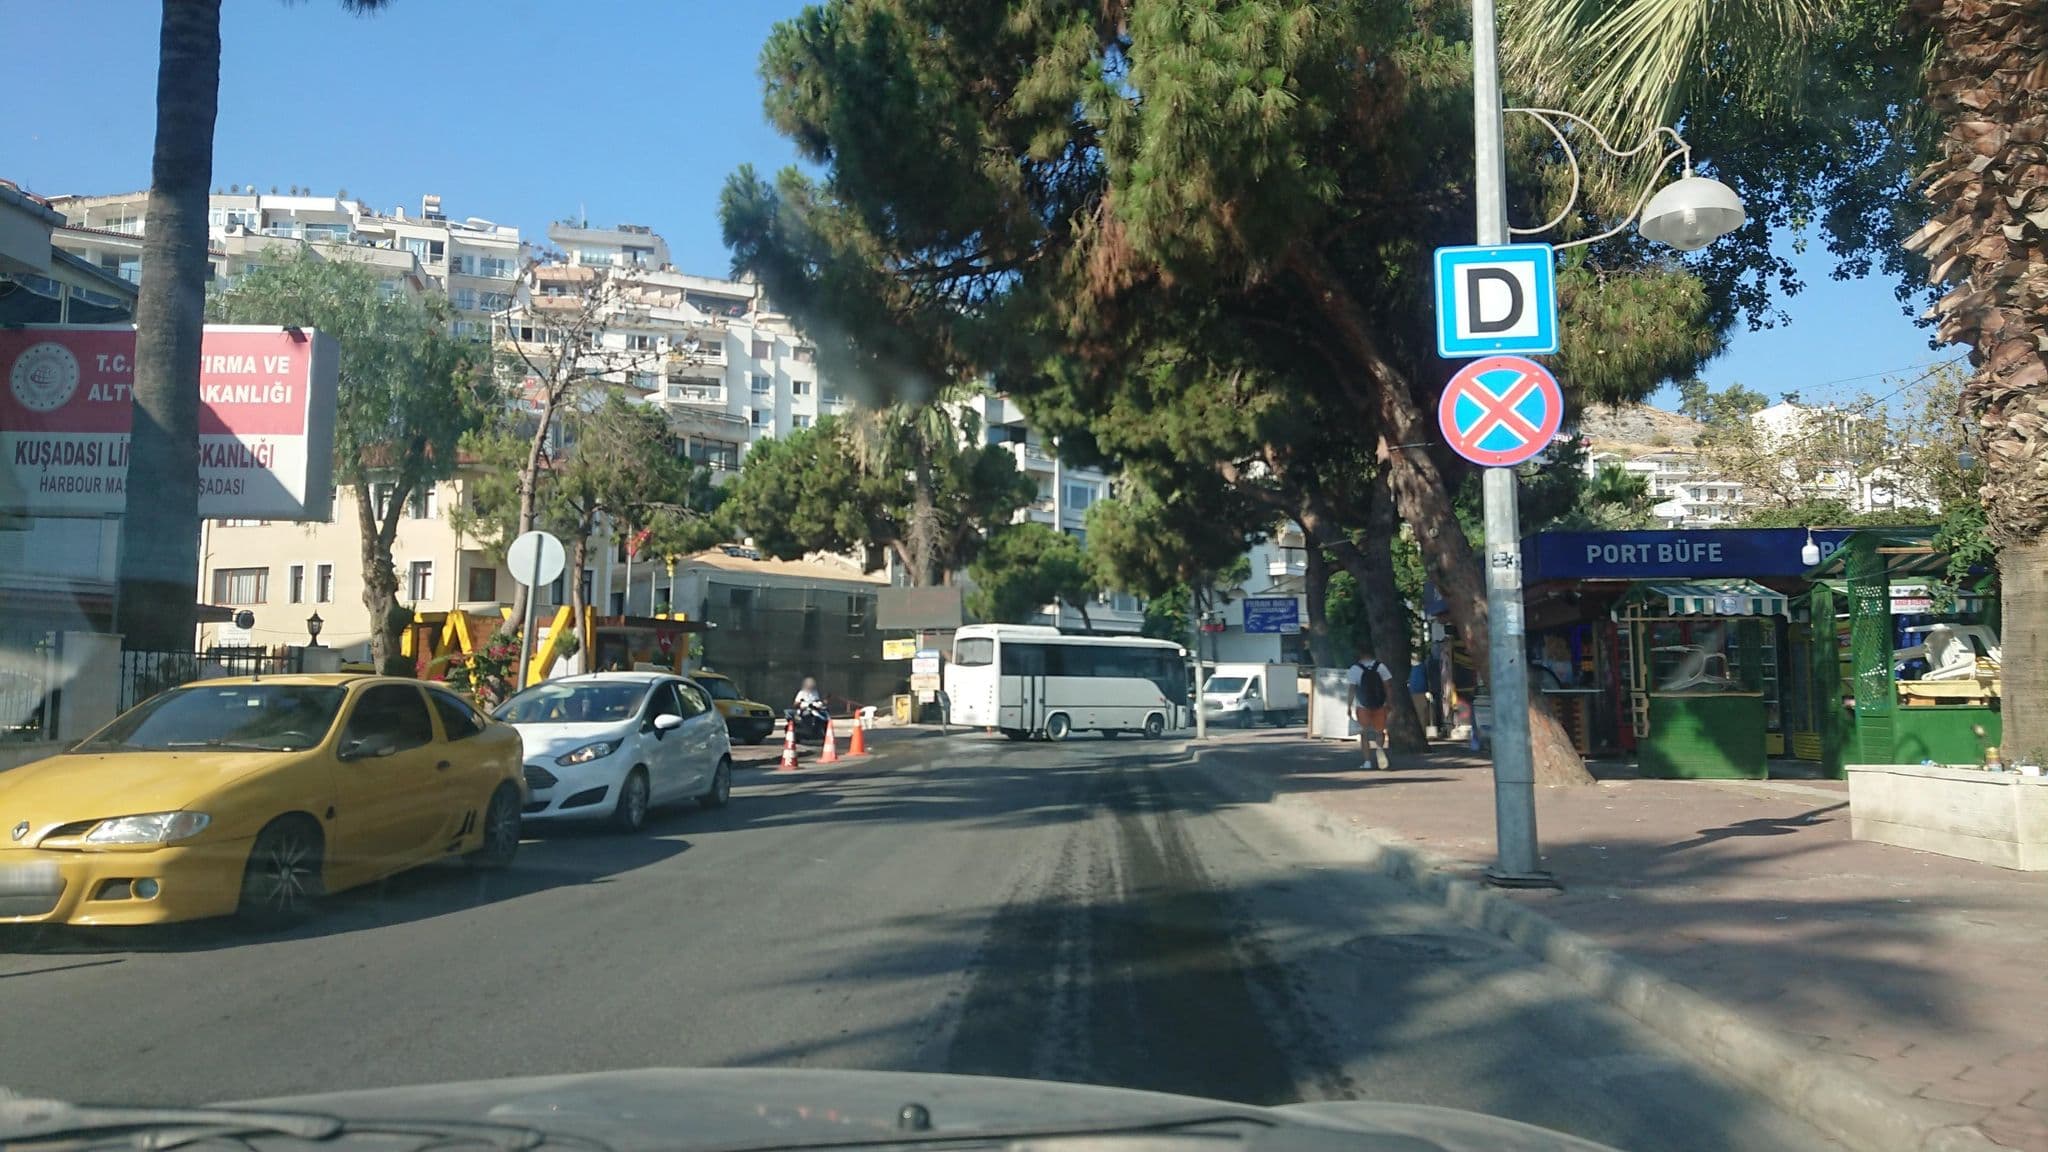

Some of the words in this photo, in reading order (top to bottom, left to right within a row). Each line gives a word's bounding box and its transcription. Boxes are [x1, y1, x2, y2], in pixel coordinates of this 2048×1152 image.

[1466, 268, 1524, 333] D
[96, 355, 131, 372] T.C.
[201, 355, 257, 374] IRMA
[263, 355, 291, 374] VE
[15, 440, 102, 472] KUŞADASI
[199, 438, 274, 469] KANLIĞI
[39, 476, 102, 493] HARBOUR
[105, 477, 126, 494] MA
[199, 478, 245, 496] ŞADASI
[1586, 543, 1652, 564] PORT
[1657, 539, 1723, 563] BÜFE
